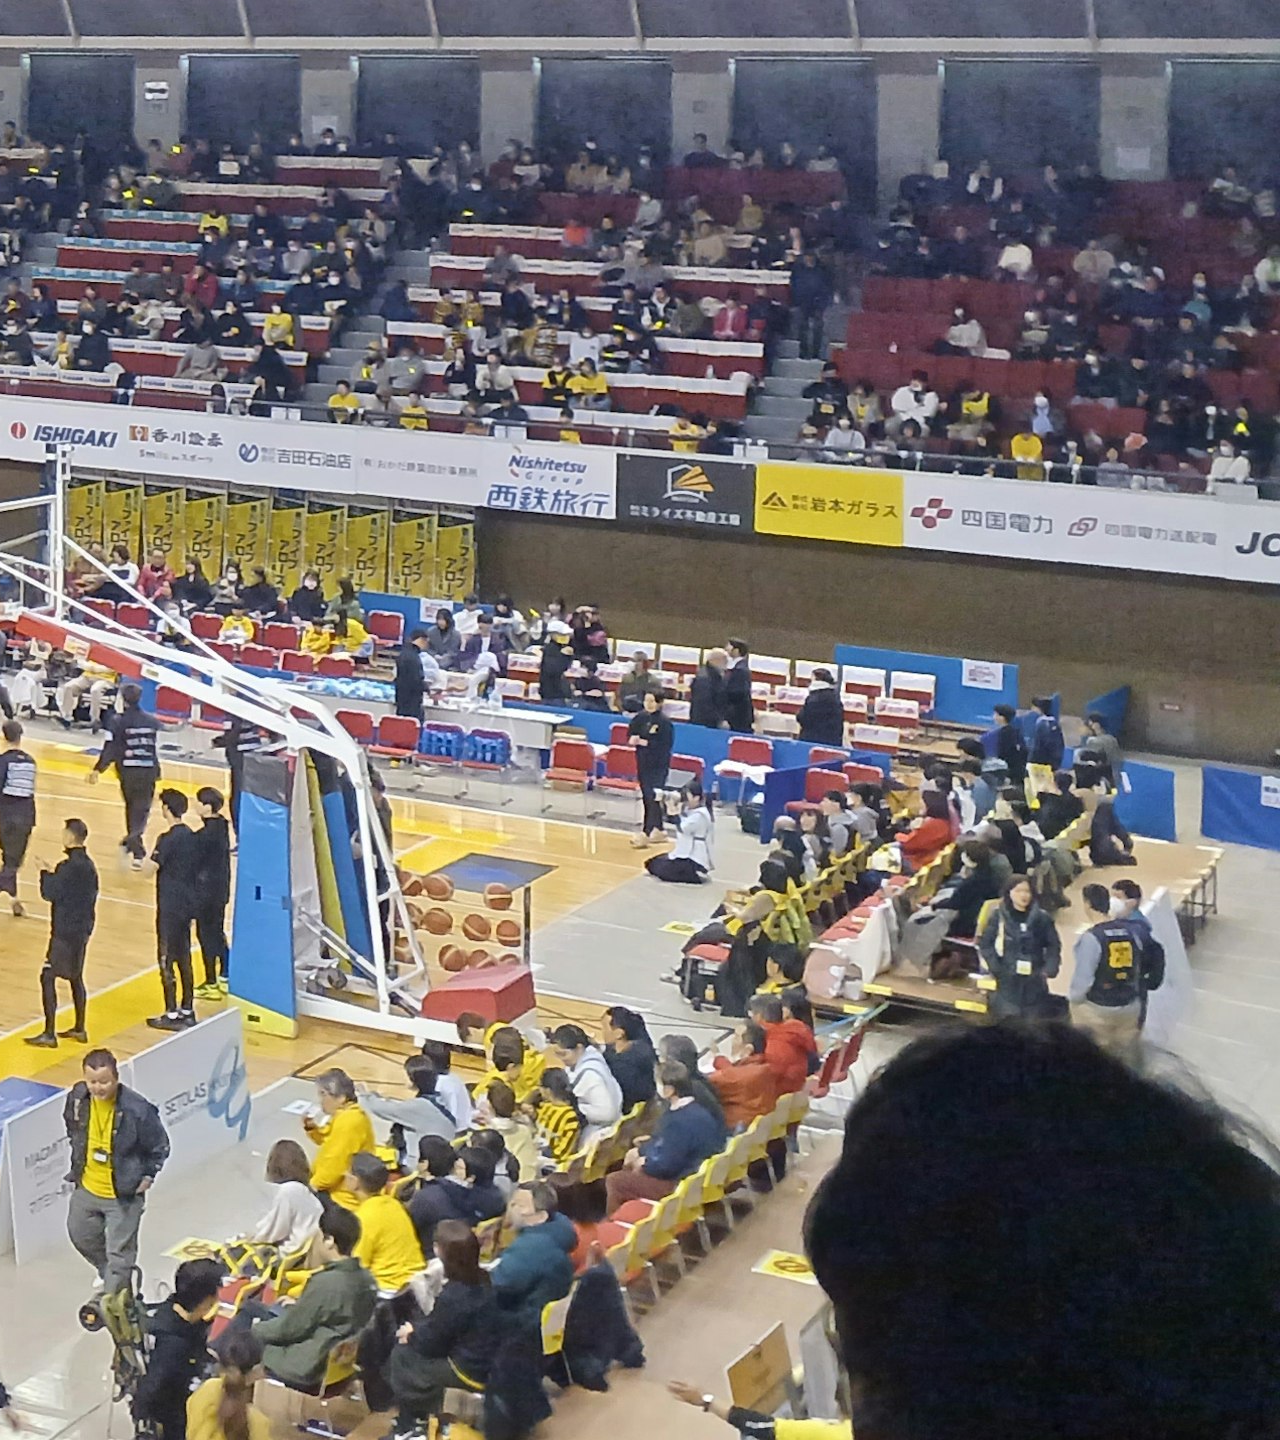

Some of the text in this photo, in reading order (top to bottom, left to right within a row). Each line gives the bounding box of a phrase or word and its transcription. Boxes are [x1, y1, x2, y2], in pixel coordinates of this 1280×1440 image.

[33, 425, 118, 448] ISHIGAKI
[277, 448, 351, 469] 吉田石油店
[508, 455, 587, 474] Nishitetsu
[487, 483, 610, 516] 西鉄旅行
[811, 497, 899, 519] 岩本ガラス
[961, 510, 1053, 534] 四国電力
